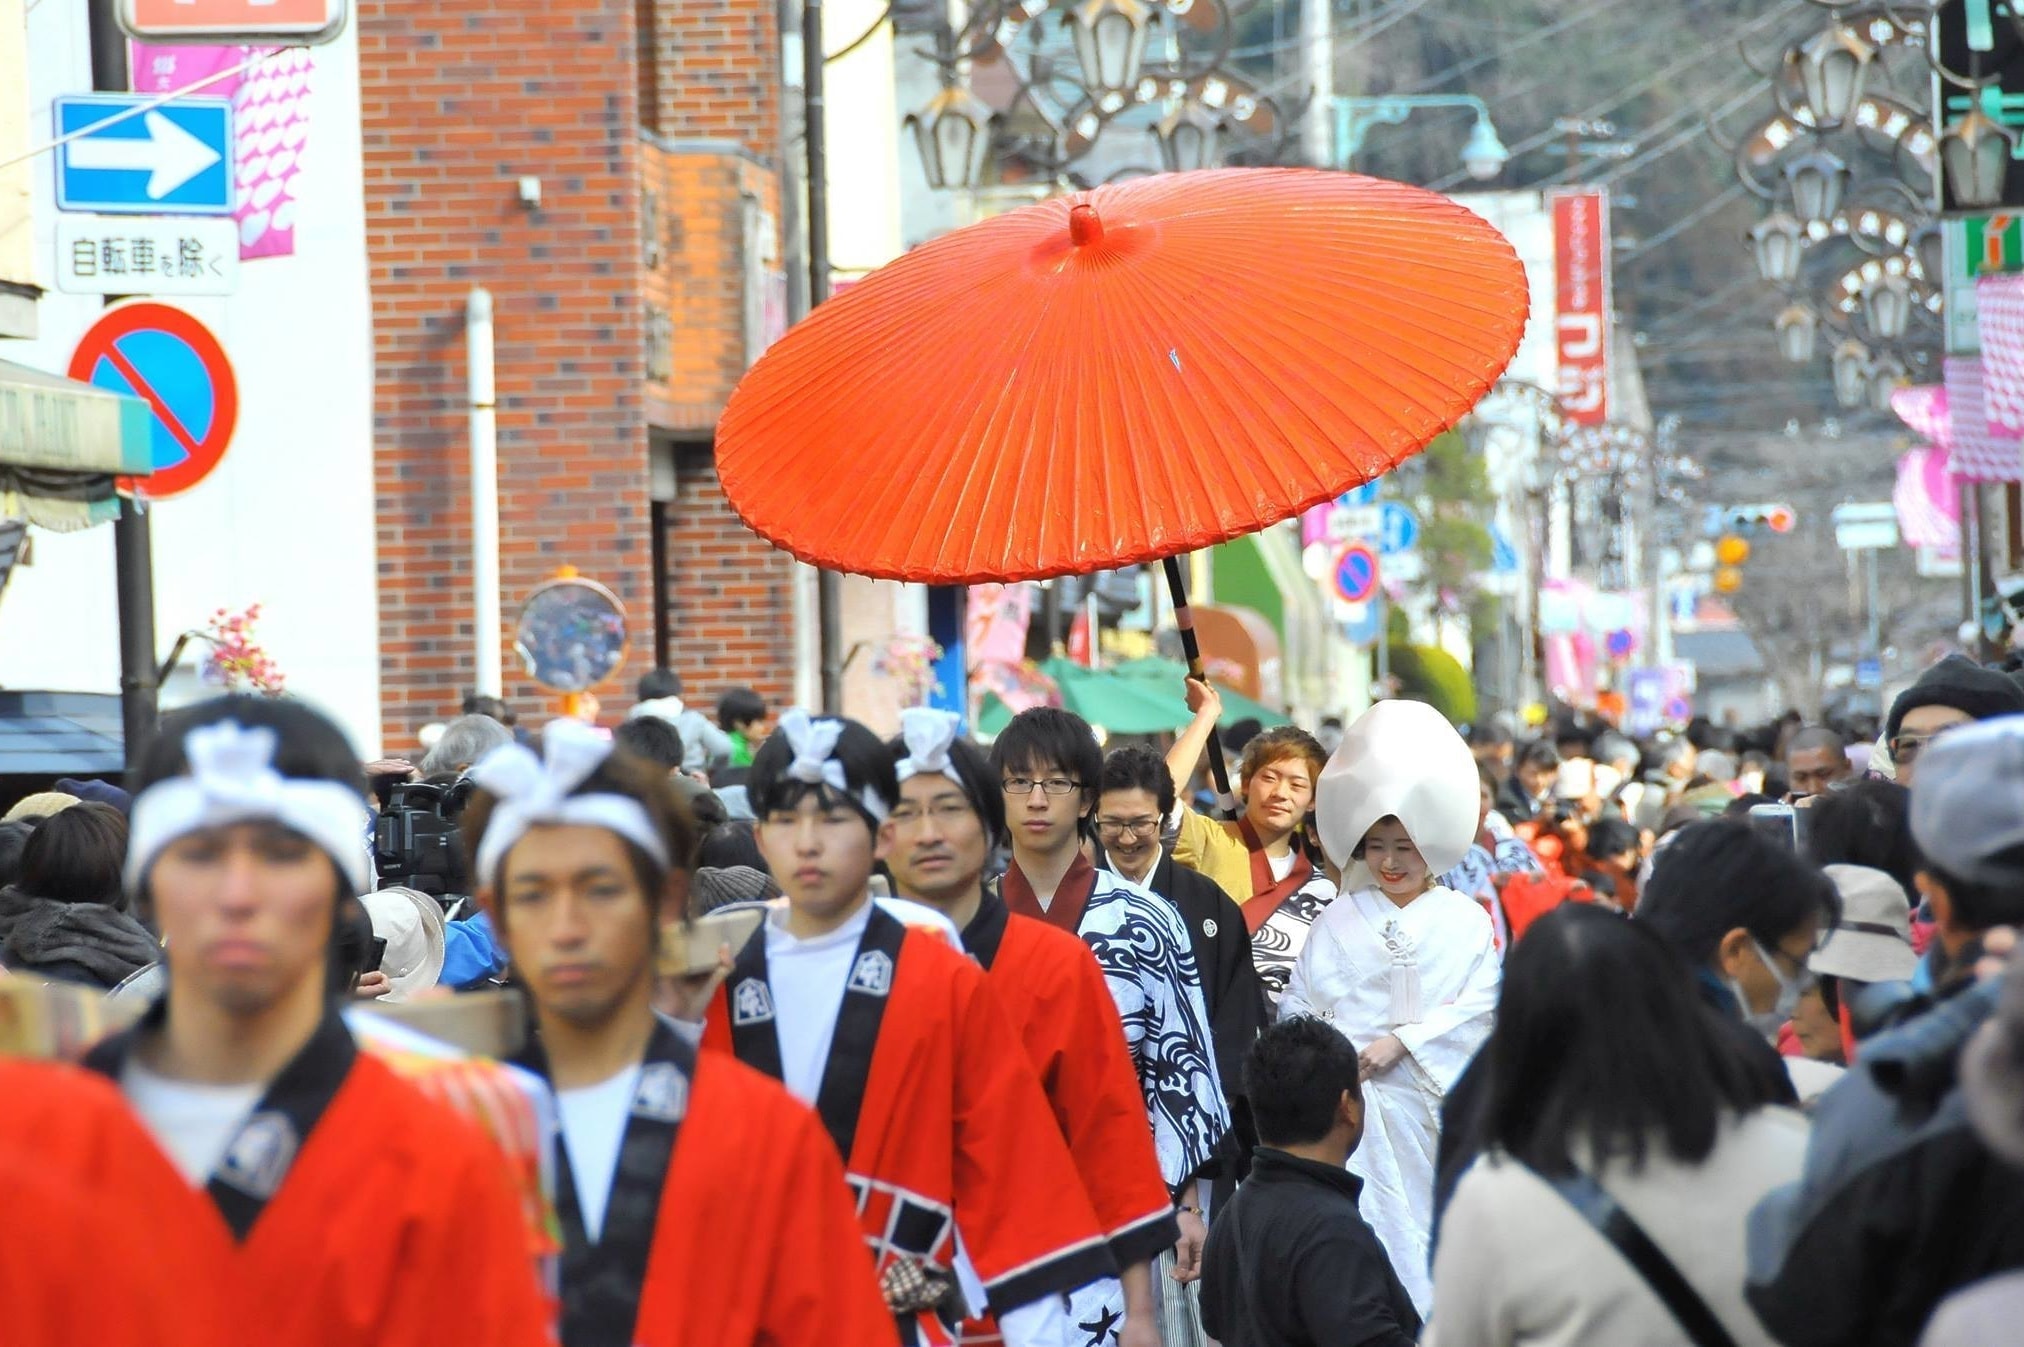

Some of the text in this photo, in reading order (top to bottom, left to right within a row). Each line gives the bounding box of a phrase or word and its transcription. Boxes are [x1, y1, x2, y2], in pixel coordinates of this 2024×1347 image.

[73, 238, 223, 278] 自転車を除く
